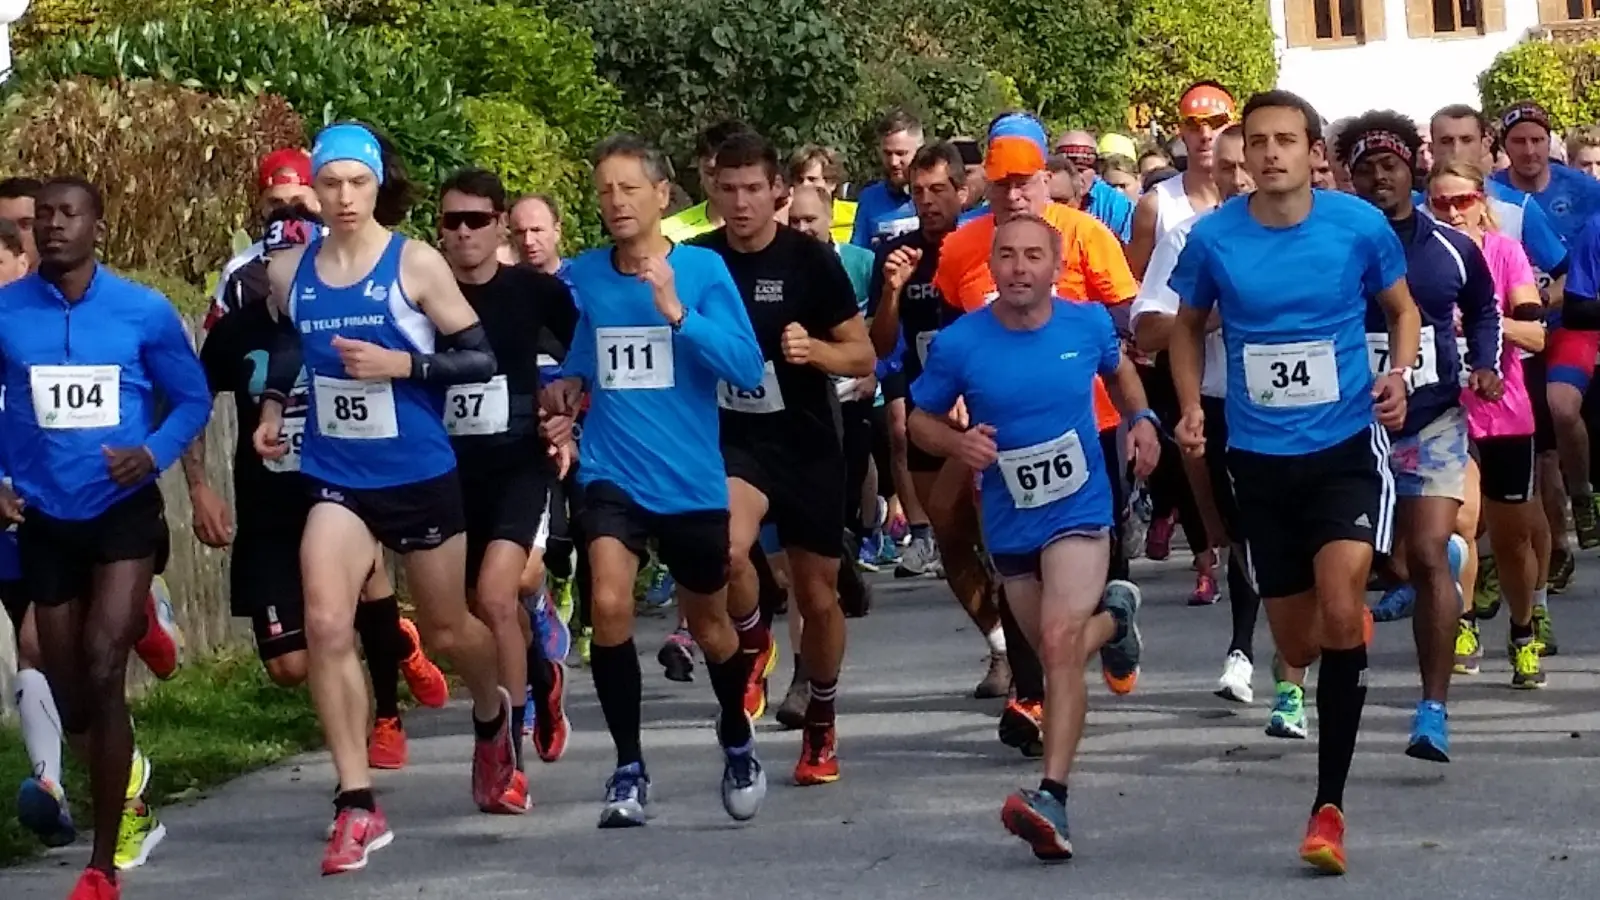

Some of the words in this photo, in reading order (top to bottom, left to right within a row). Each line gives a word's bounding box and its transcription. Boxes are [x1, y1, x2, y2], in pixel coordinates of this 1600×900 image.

[906, 283, 939, 300] CR
[313, 318, 341, 331] TELIS
[343, 314, 385, 328] FINANZ
[607, 343, 653, 370] 111
[1270, 360, 1310, 388] 34
[48, 383, 104, 409] 104
[334, 395, 368, 421] 85
[452, 393, 484, 419] 37
[1016, 453, 1073, 491] 676
